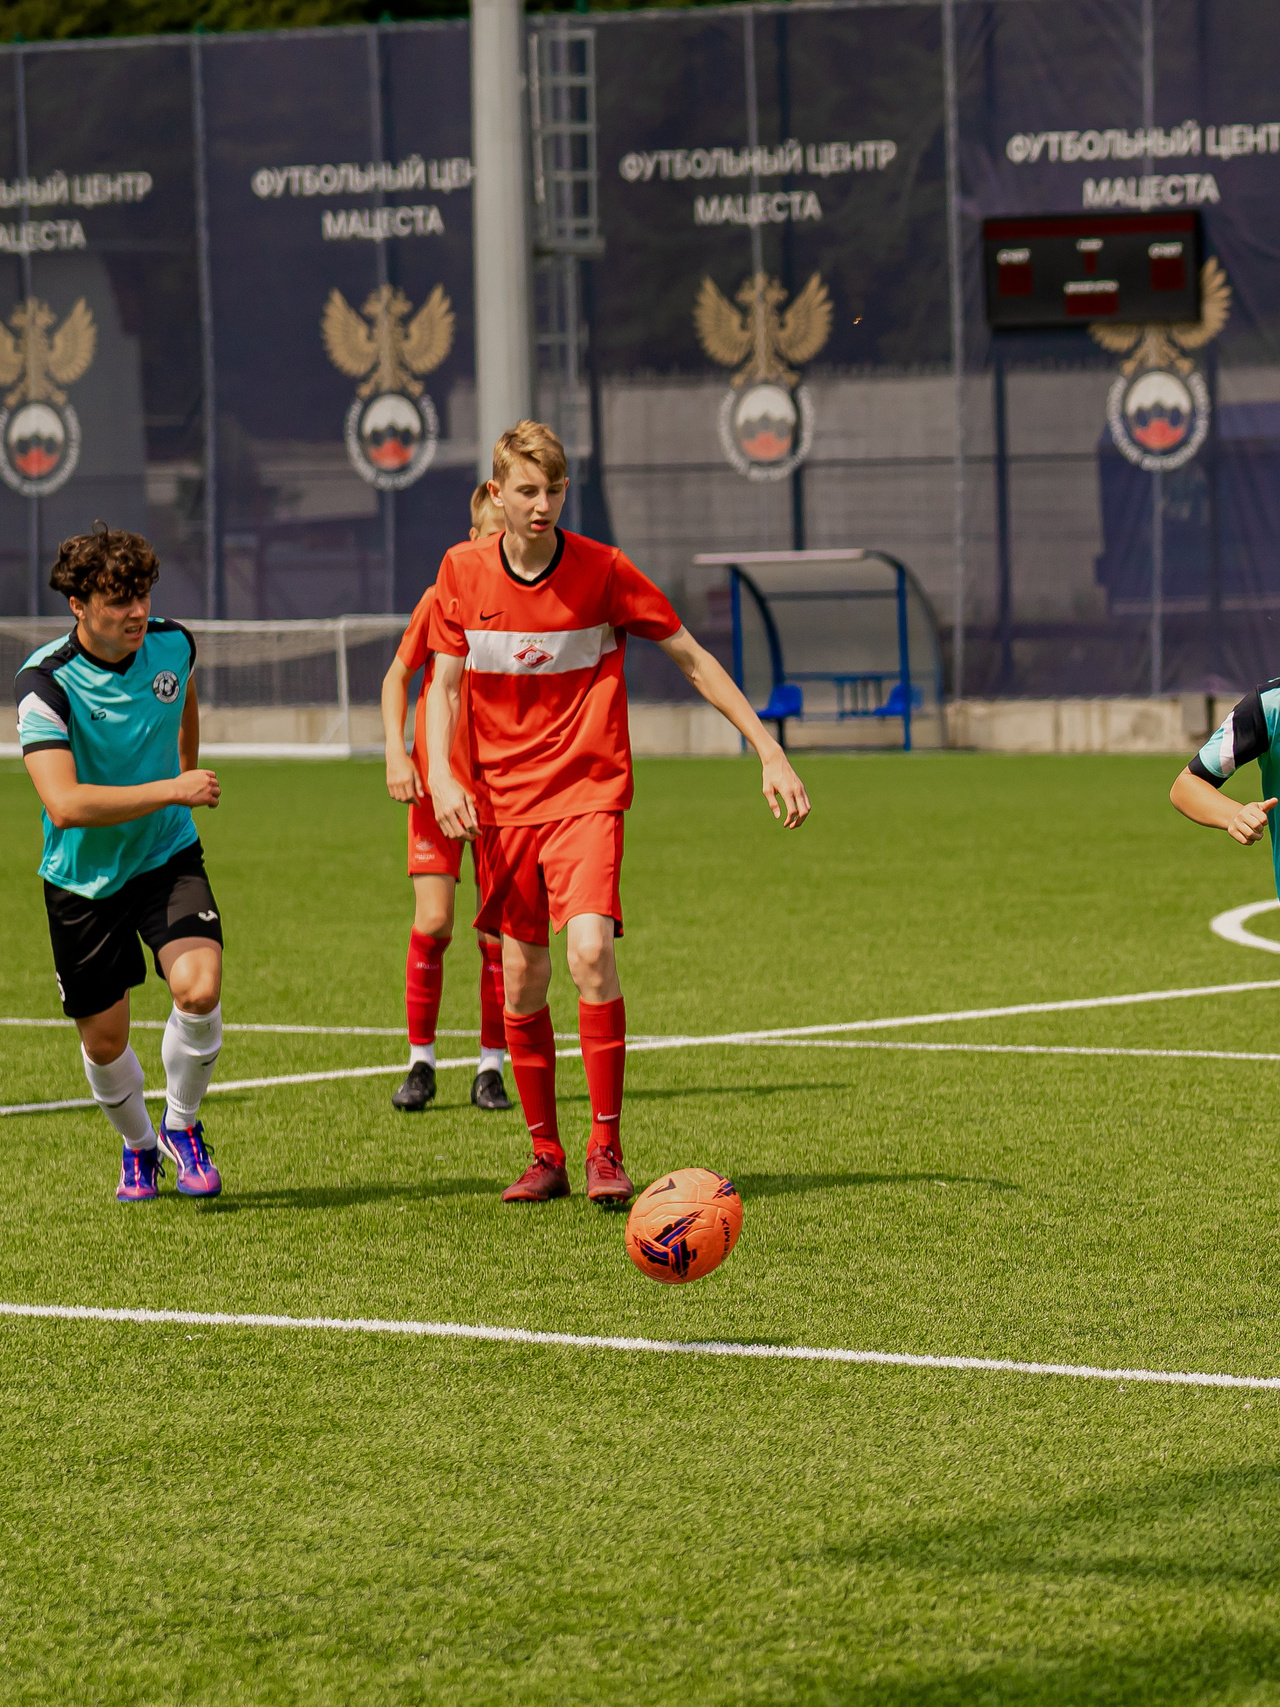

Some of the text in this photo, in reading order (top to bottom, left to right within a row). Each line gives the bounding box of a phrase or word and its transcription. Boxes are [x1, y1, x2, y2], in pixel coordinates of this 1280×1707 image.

[619, 137, 898, 182] ФУТБОЛЬНЫЙ ЦЕНТР
[1005, 119, 1201, 165] ФУТБОЛЬНЫЙ
[72, 171, 153, 210] ЦЕНТР
[251, 153, 426, 200] ФУТБОЛЬНЫЙ
[1082, 172, 1221, 212] МАЦЕСТА
[321, 204, 445, 244] МАЦЕСТА
[694, 191, 823, 227] МАЦЕСТА
[0, 219, 87, 257] АЦЕСТА
